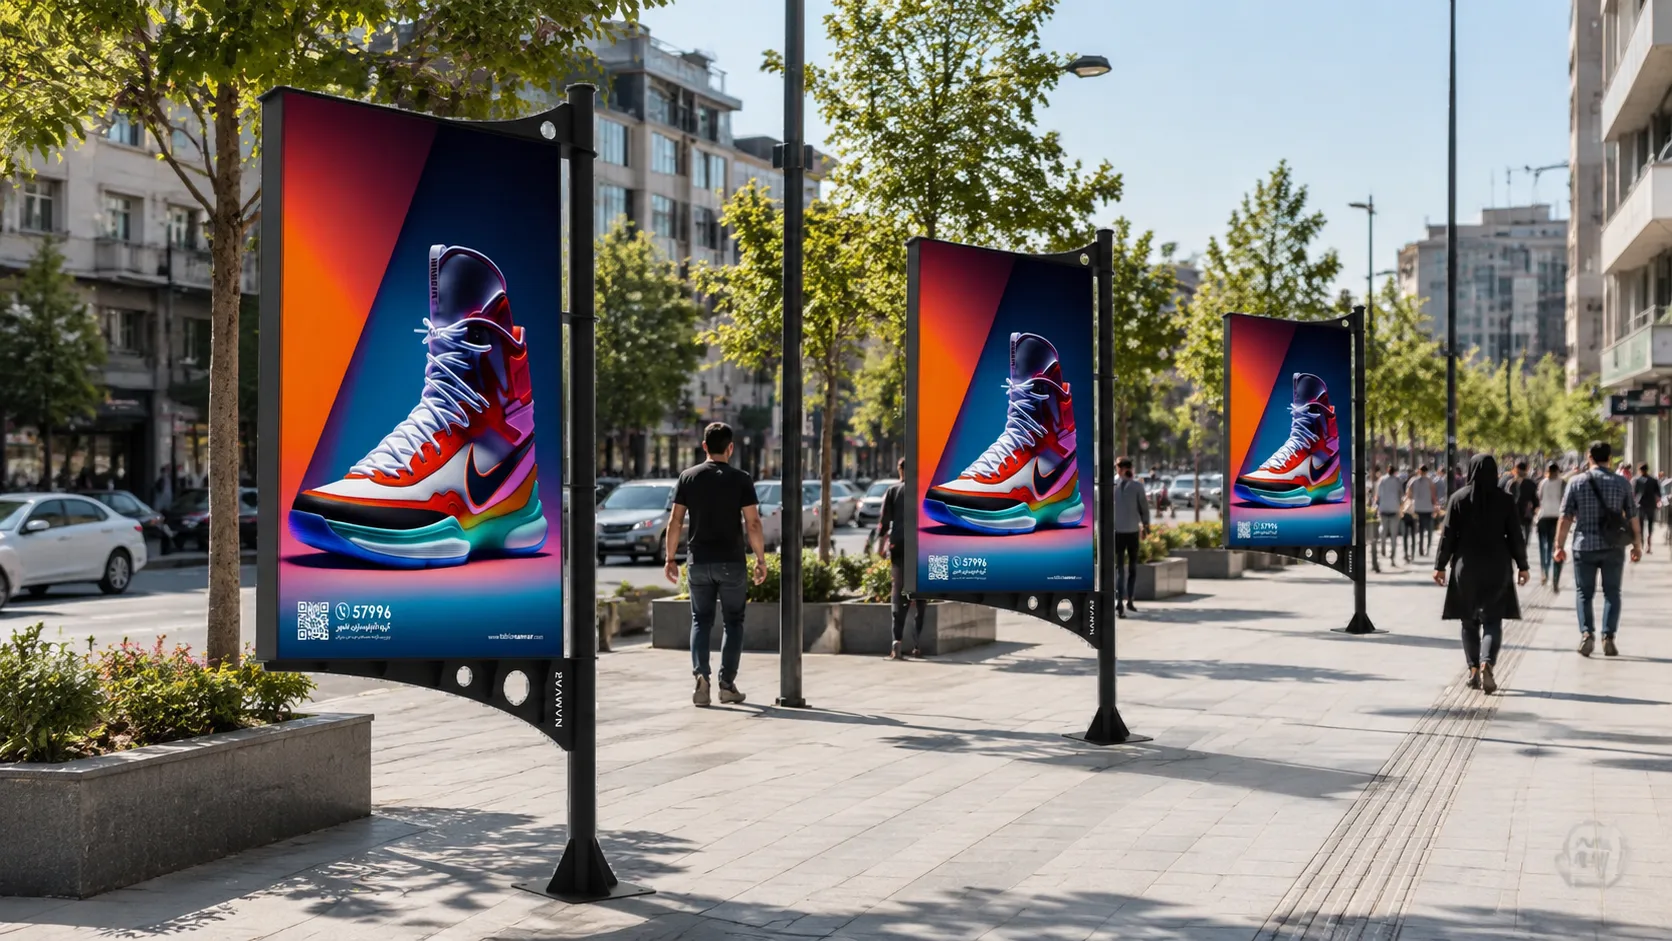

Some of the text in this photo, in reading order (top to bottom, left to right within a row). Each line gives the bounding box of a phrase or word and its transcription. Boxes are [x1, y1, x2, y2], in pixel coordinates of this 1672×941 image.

[962, 557, 987, 567] 57996
[352, 605, 391, 619] 57996
[555, 671, 563, 728] NAMVAR
